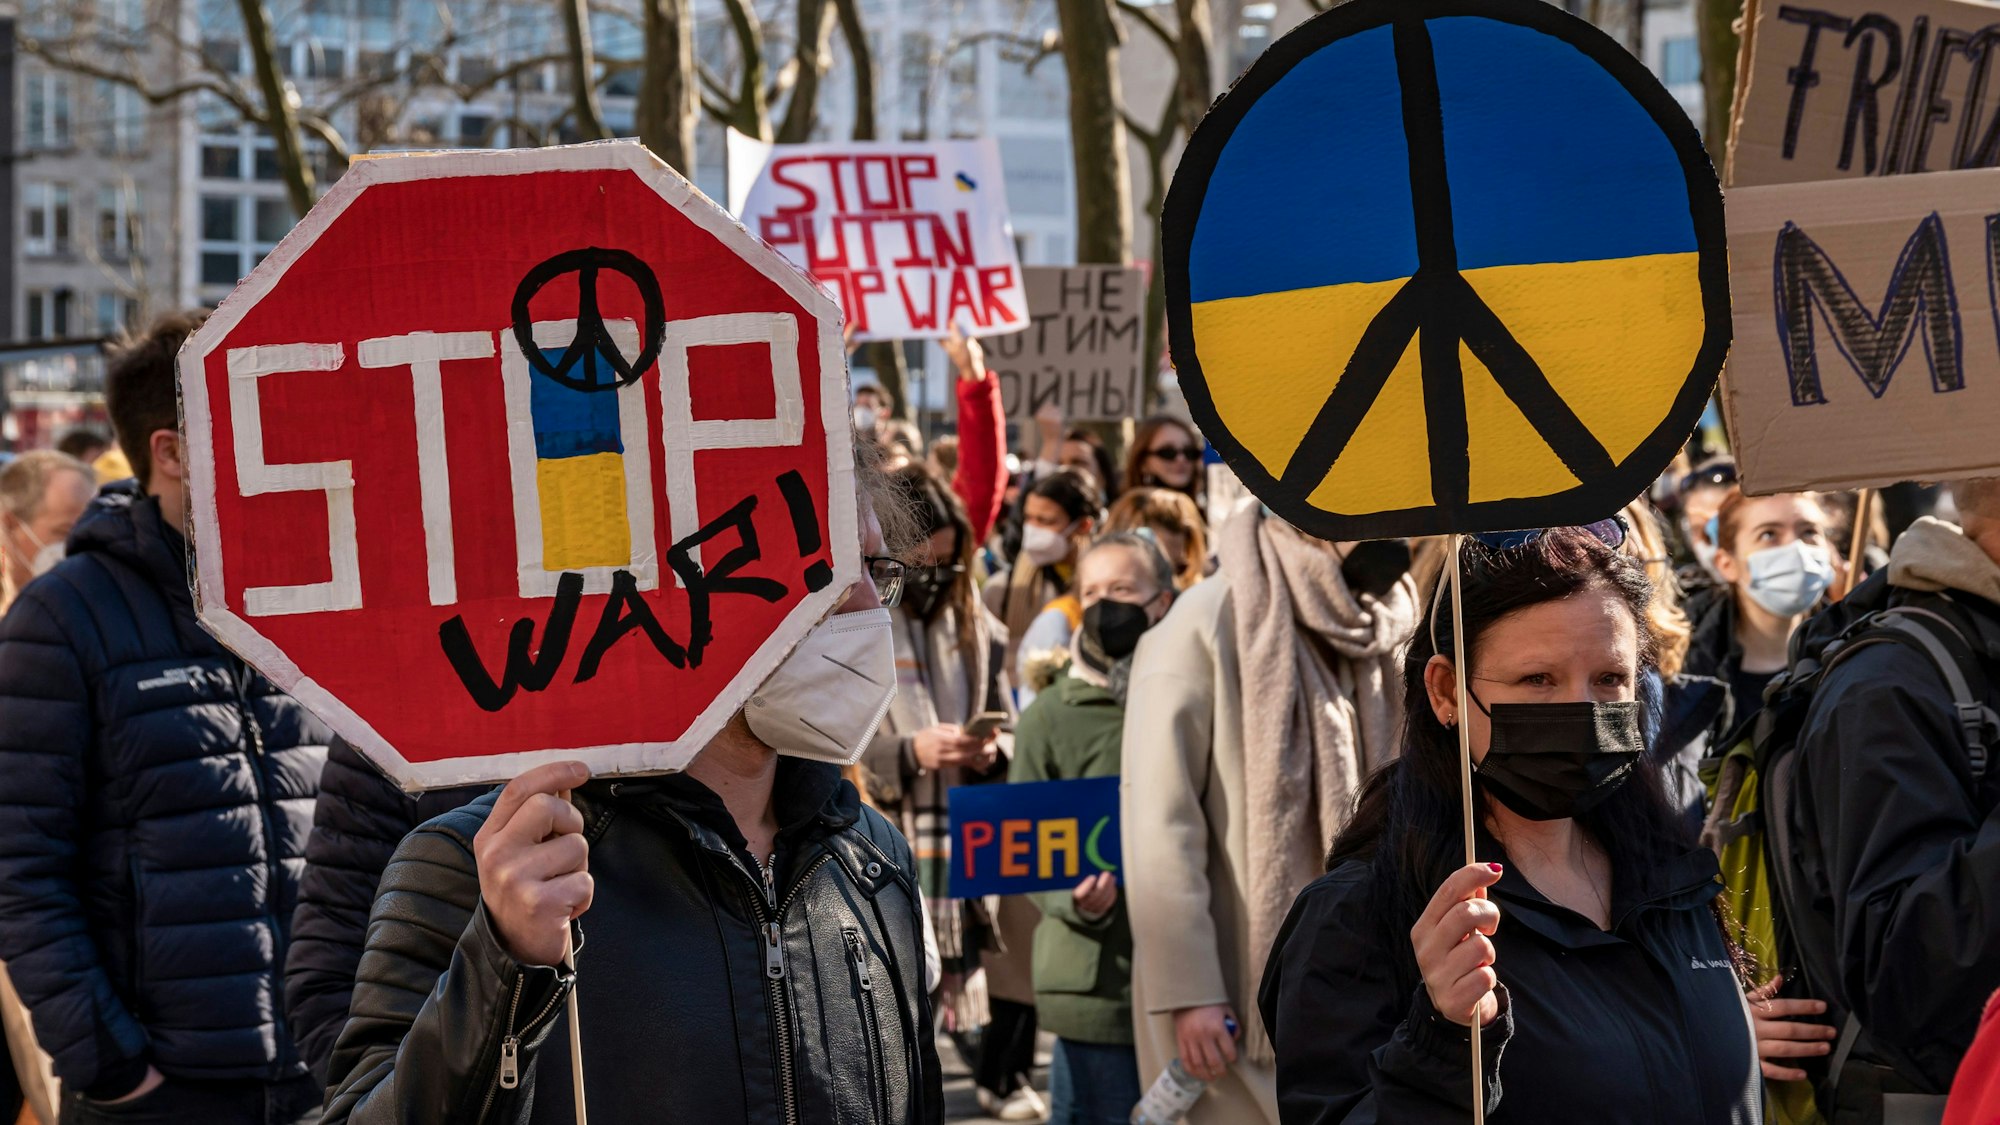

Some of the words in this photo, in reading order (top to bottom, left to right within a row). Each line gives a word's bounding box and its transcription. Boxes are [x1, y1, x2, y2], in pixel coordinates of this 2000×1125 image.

[770, 154, 938, 214] STOP
[759, 211, 975, 274] PUTIN
[897, 264, 1018, 331] WAR
[1060, 270, 1123, 312] НЕ
[1773, 210, 2000, 407] M
[981, 313, 1138, 360] ОТИМ
[1000, 365, 1137, 419] ОЙНЫ
[227, 312, 804, 617] STOP
[438, 469, 833, 712] WAR!
[961, 815, 1118, 880] PEAC
[1706, 959, 1732, 969] VAU
